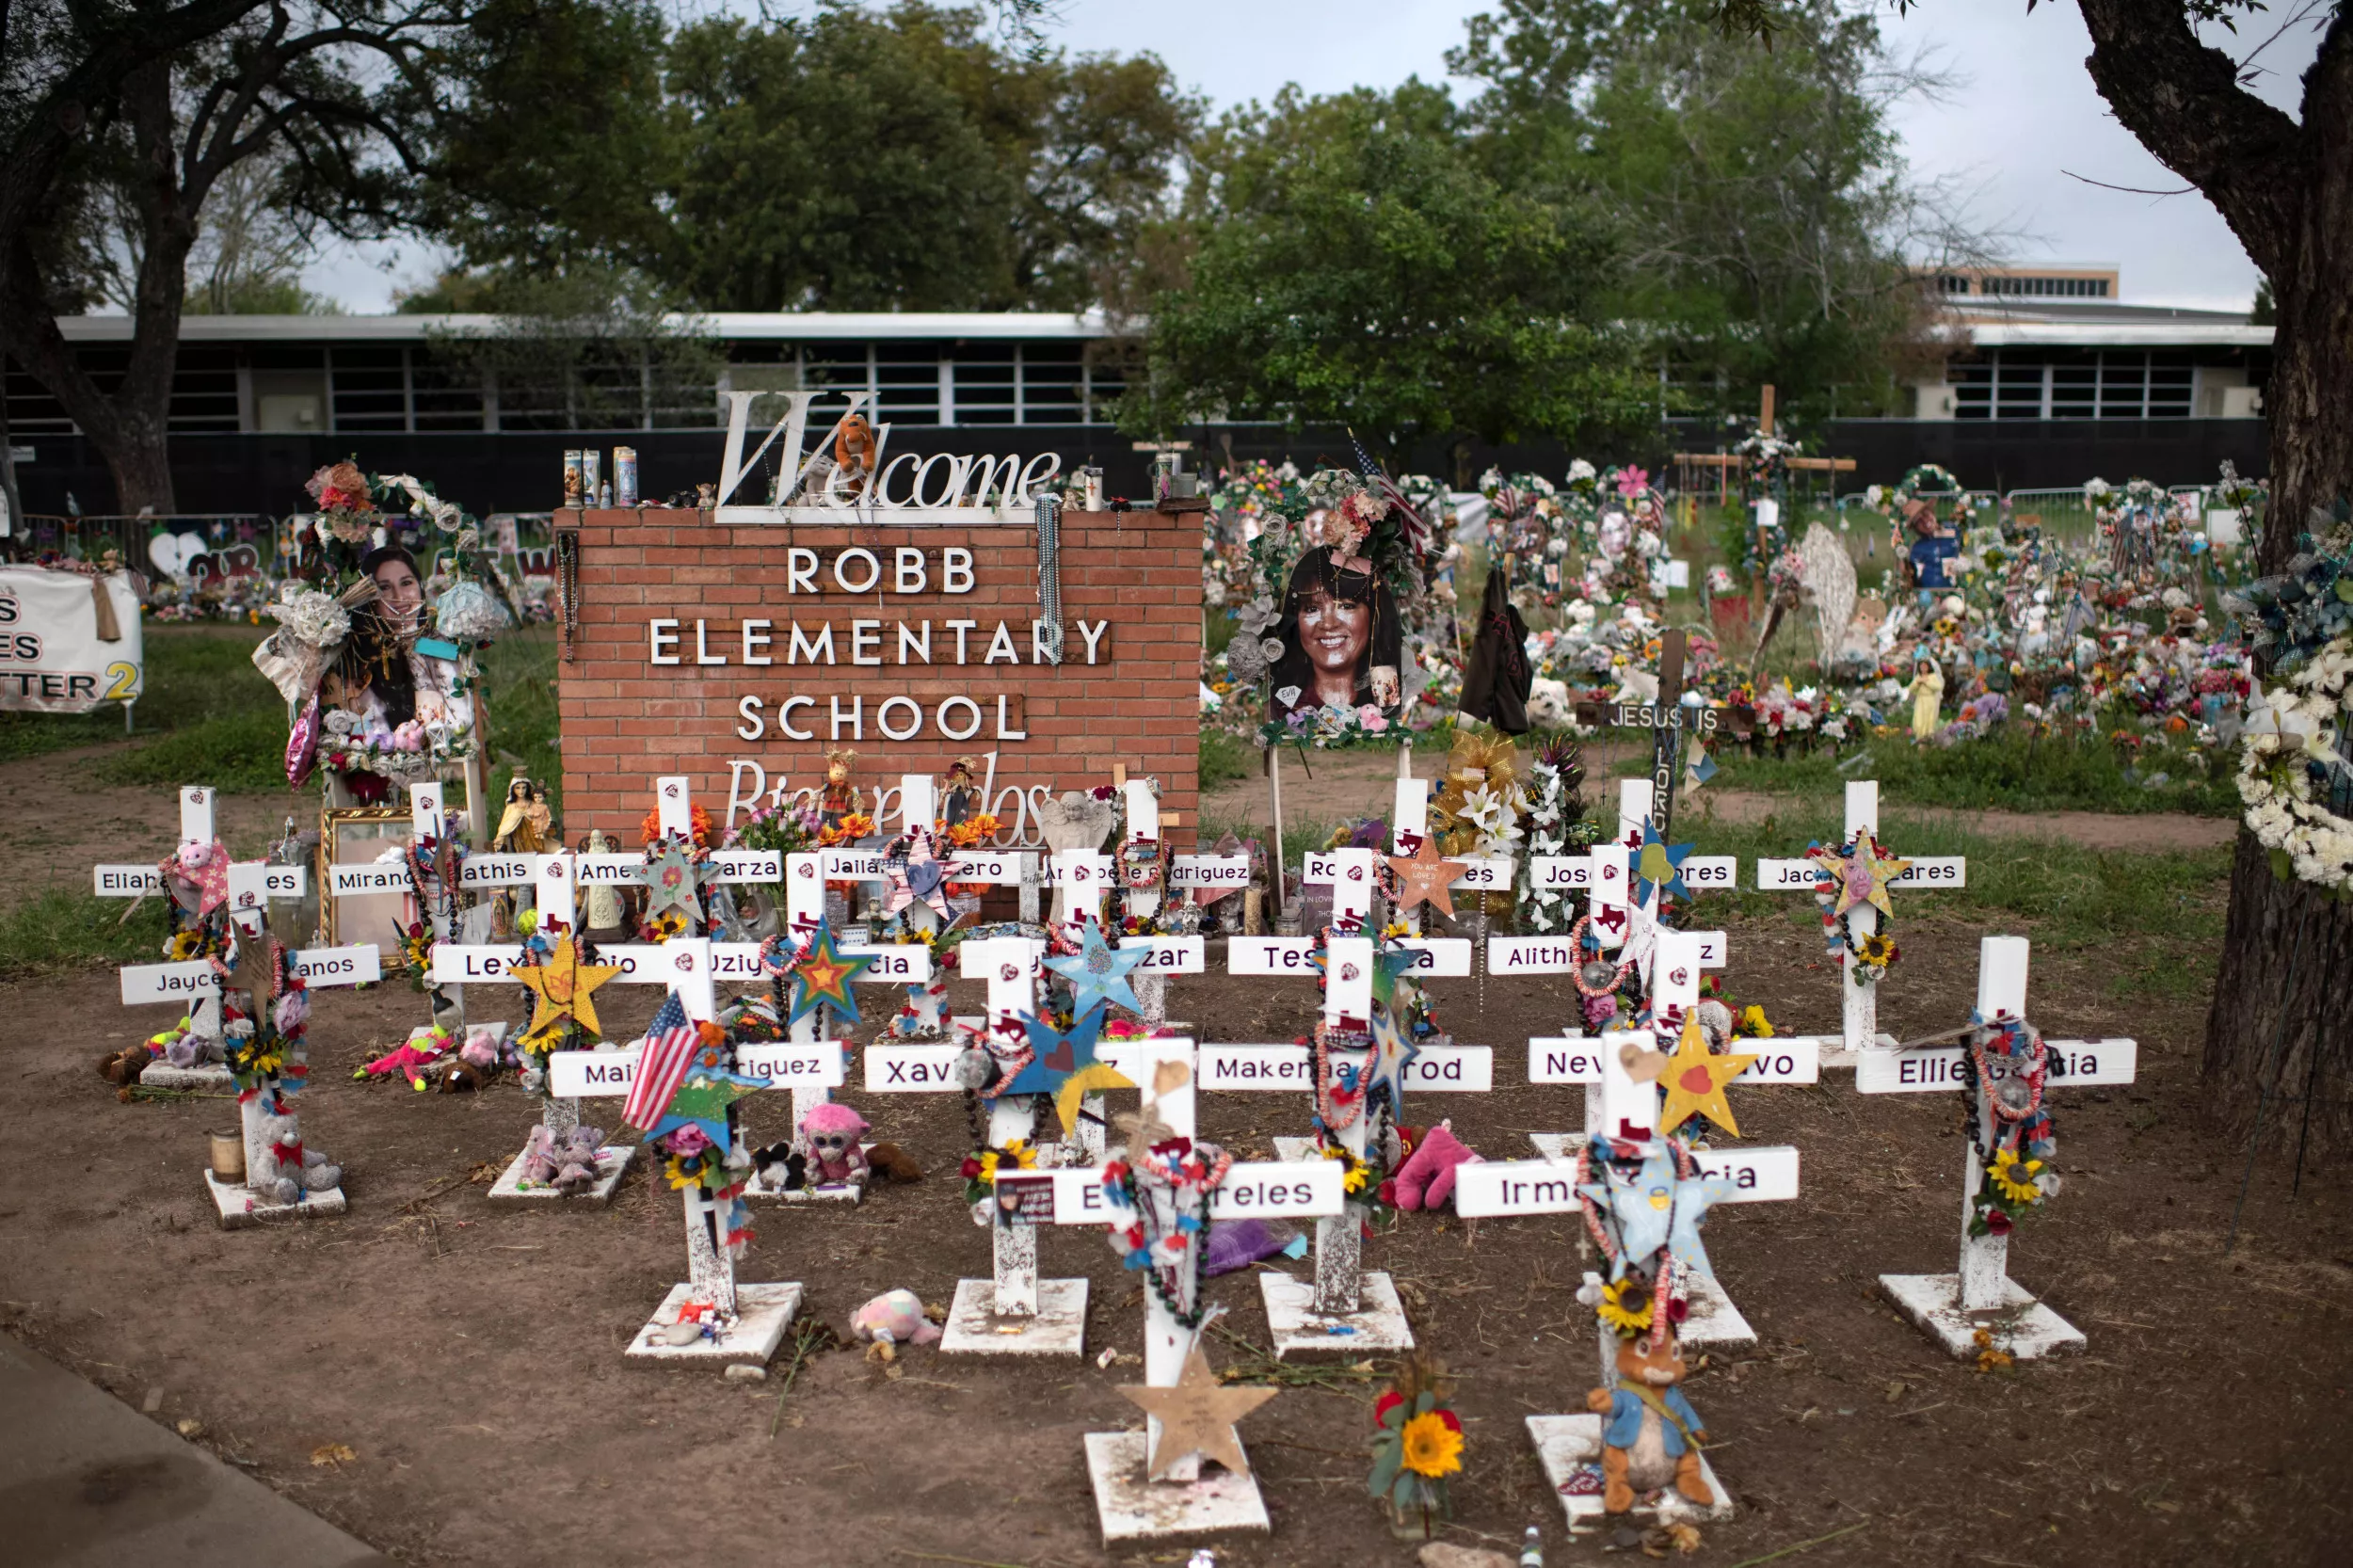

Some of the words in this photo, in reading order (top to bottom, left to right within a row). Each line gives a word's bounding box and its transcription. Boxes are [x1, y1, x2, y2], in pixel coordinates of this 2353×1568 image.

[718, 391, 1062, 509] Welcome
[787, 547, 975, 595] ROBB
[649, 618, 1108, 665] ELEMENTARY
[104, 661, 139, 699] 2
[1281, 687, 1296, 698] EVA
[738, 695, 1027, 741] SCHOOL
[1609, 706, 1683, 728] JESUS
[1698, 709, 1718, 730] IS
[1654, 746, 1670, 833] LORD
[462, 862, 527, 880] athis
[581, 863, 632, 880] Ame
[723, 861, 777, 876] arza
[830, 857, 885, 874] Jaila
[1546, 866, 1591, 883] Jos
[1899, 865, 1956, 881] ares
[103, 872, 164, 889] Eliah
[1022, 871, 1043, 887] aith
[1315, 895, 1334, 904] LOVIN
[297, 958, 355, 976] anos
[585, 1064, 632, 1083] Mai
[887, 1060, 951, 1083] Xav
[1402, 1058, 1462, 1080] rod
[1547, 1052, 1603, 1075] Nev
[1899, 1056, 1967, 1084] Ellie
[1213, 1180, 1313, 1208] reles
